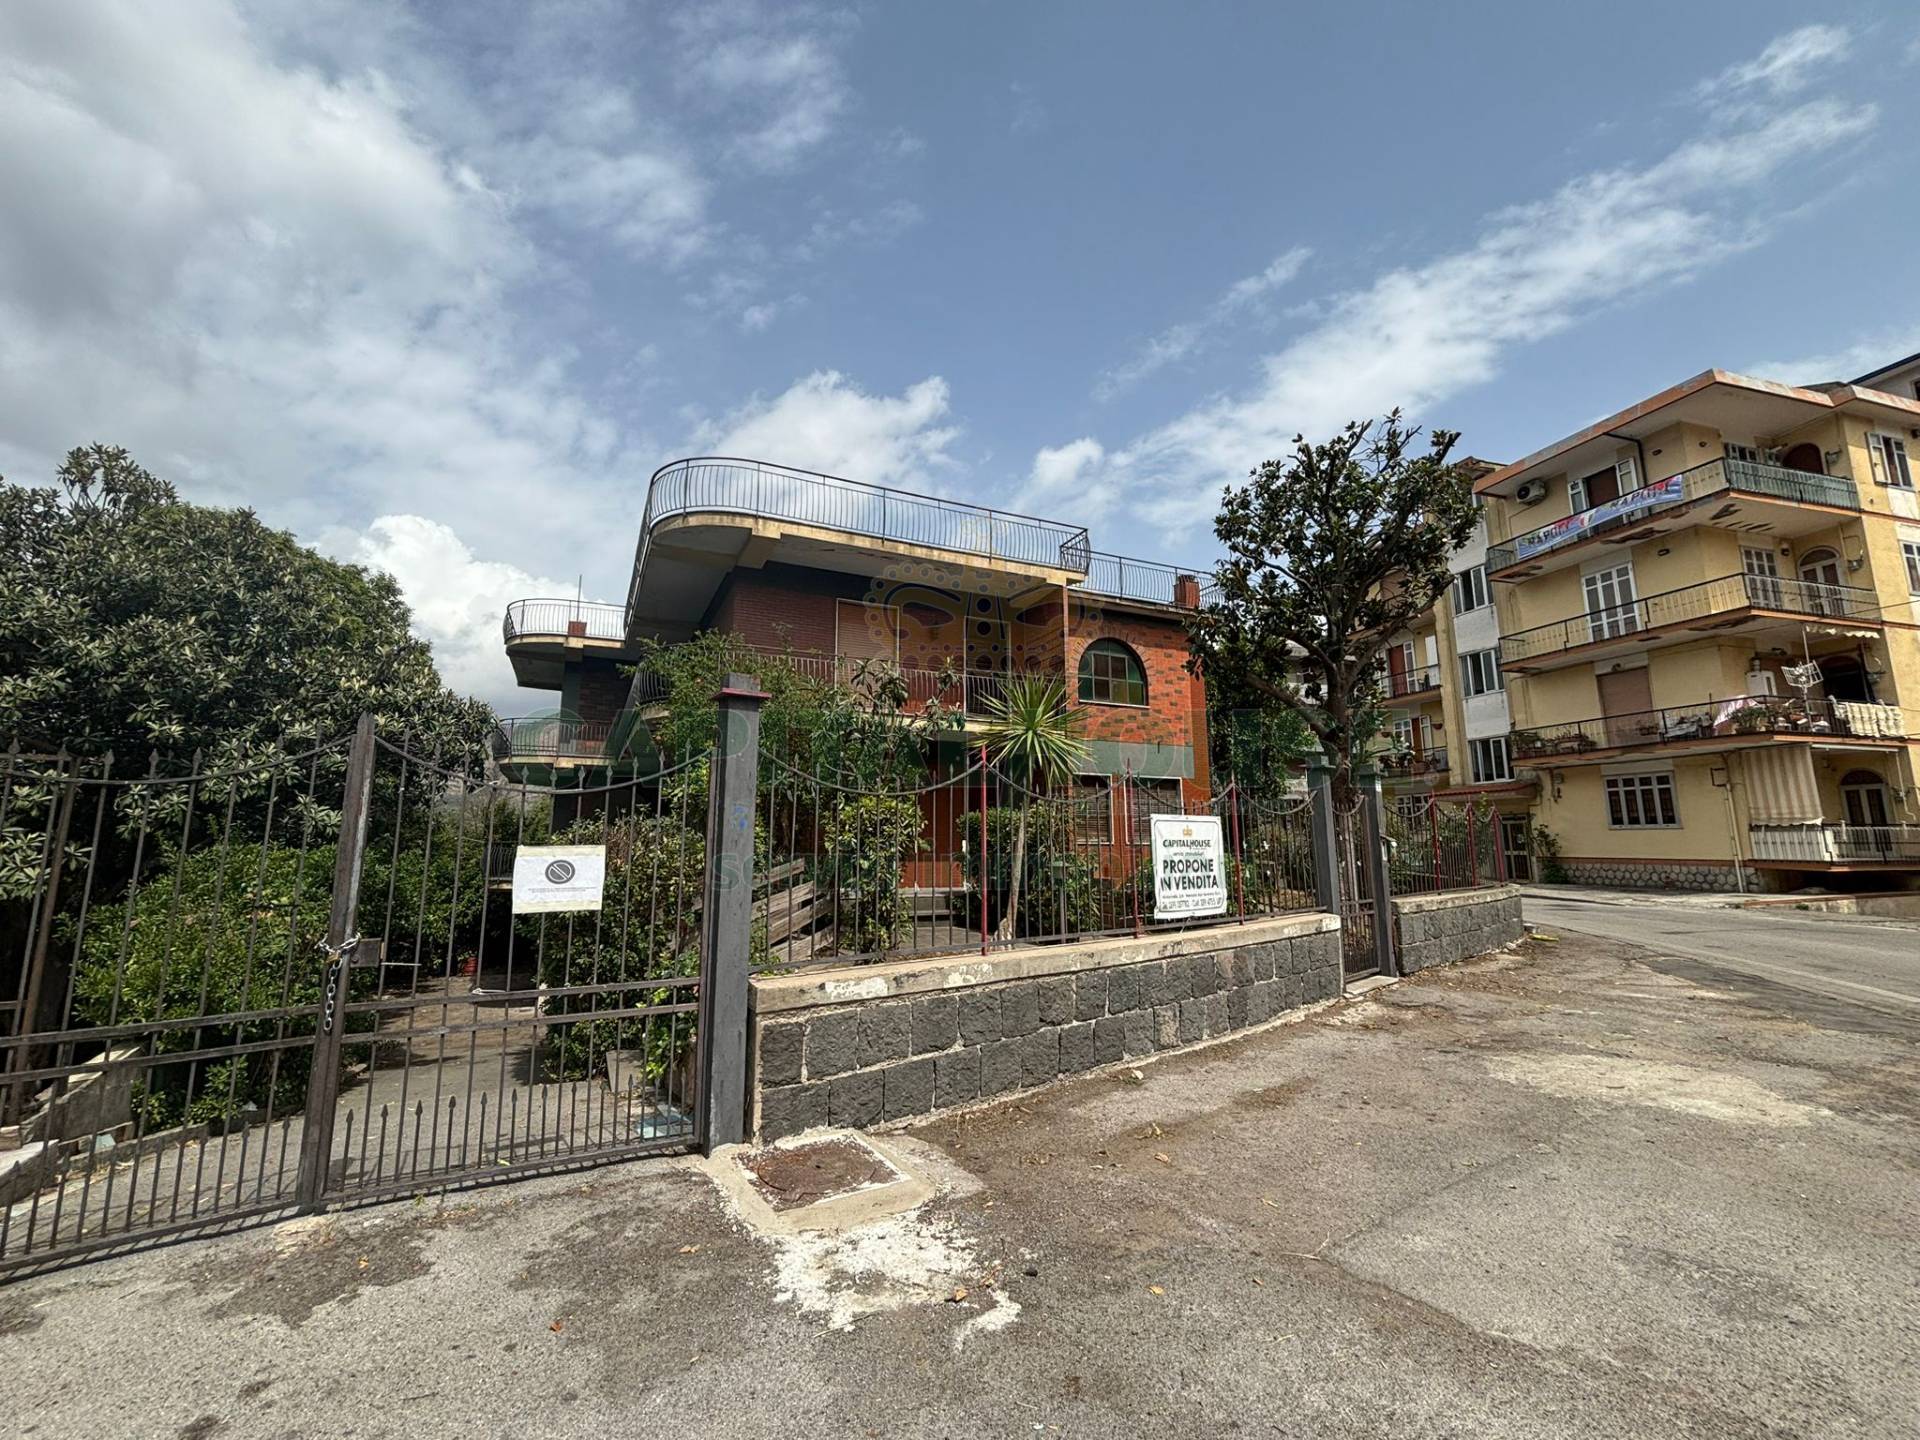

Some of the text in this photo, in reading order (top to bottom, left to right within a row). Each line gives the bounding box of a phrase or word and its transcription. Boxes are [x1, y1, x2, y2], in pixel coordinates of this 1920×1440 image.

[1163, 839, 1211, 849] CAPITALHOUSE
[1163, 859, 1214, 874] PROPONE
[1160, 875, 1219, 891] IN VENDITA
